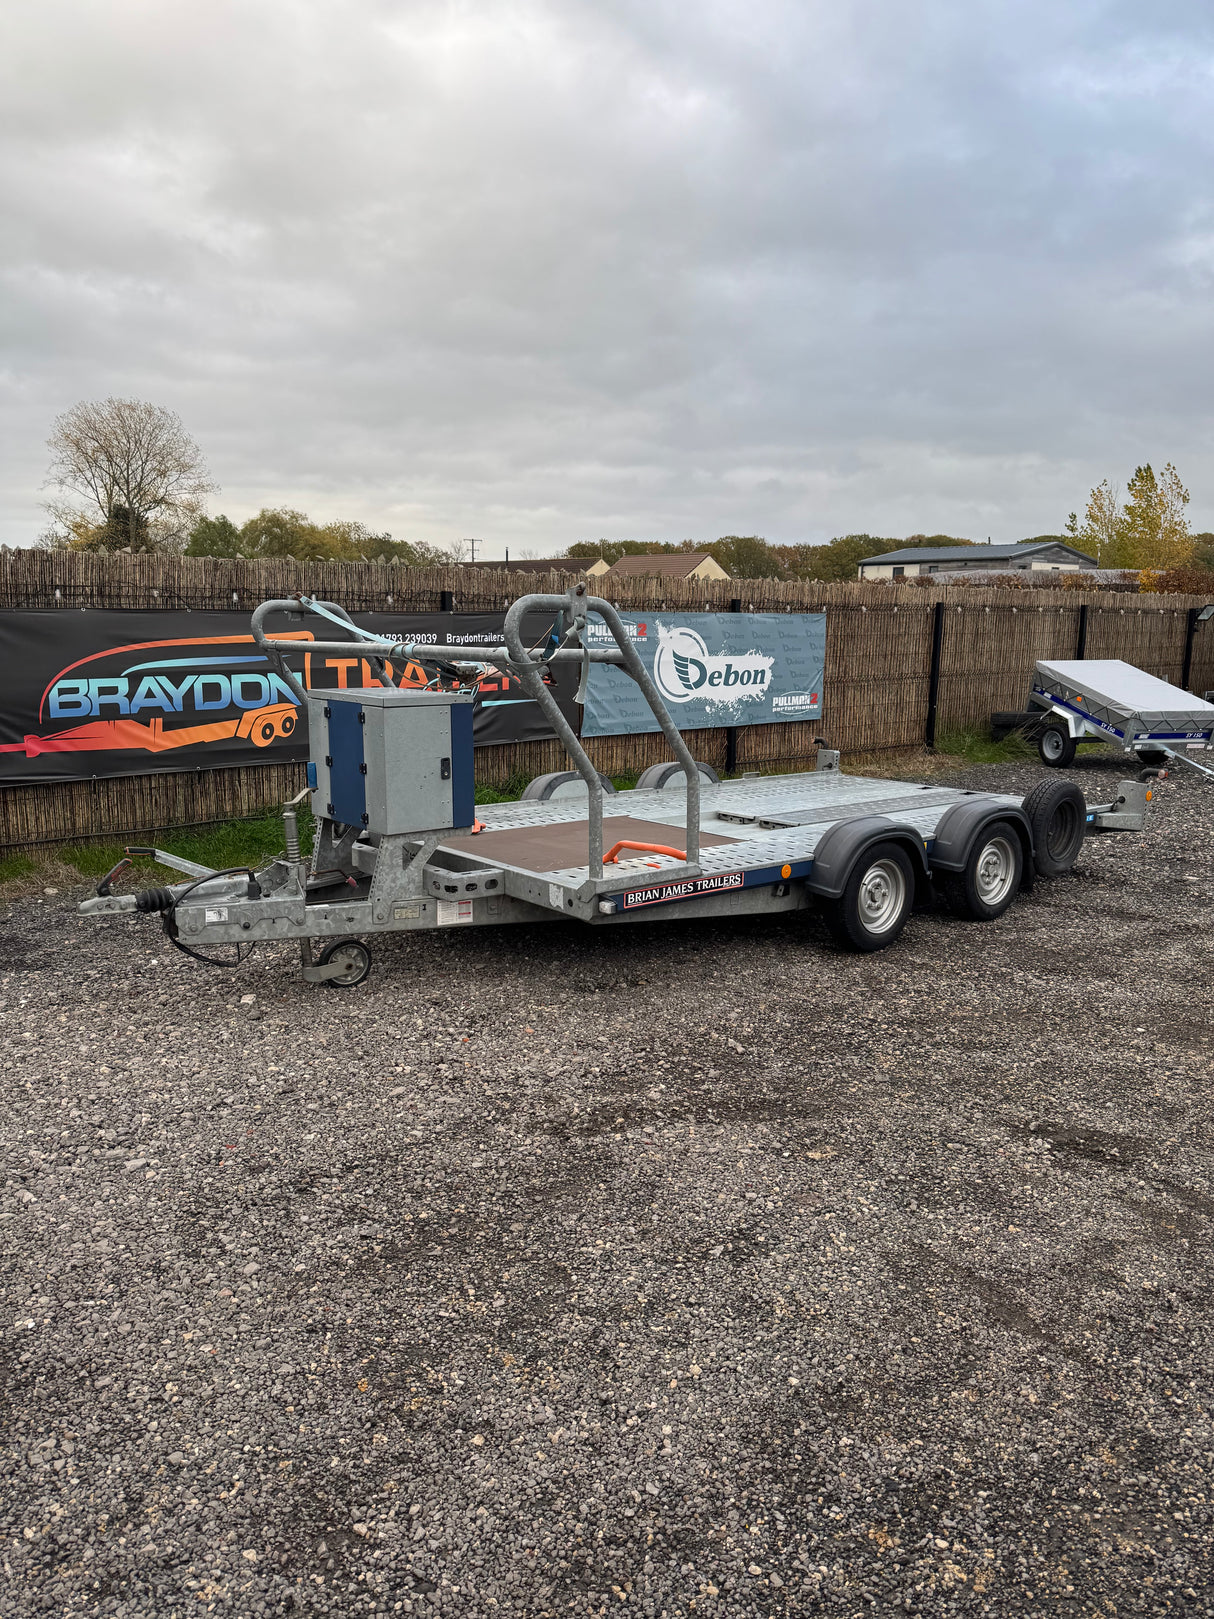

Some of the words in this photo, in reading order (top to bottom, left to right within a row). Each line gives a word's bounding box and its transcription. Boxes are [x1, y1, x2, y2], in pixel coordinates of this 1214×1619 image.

[405, 633, 438, 644] 239039
[672, 650, 766, 691] Debon
[49, 672, 303, 719] BRAYDON
[627, 889, 659, 904] BRIAN
[660, 882, 694, 899] JAMES
[696, 873, 741, 891] TRAILERS
